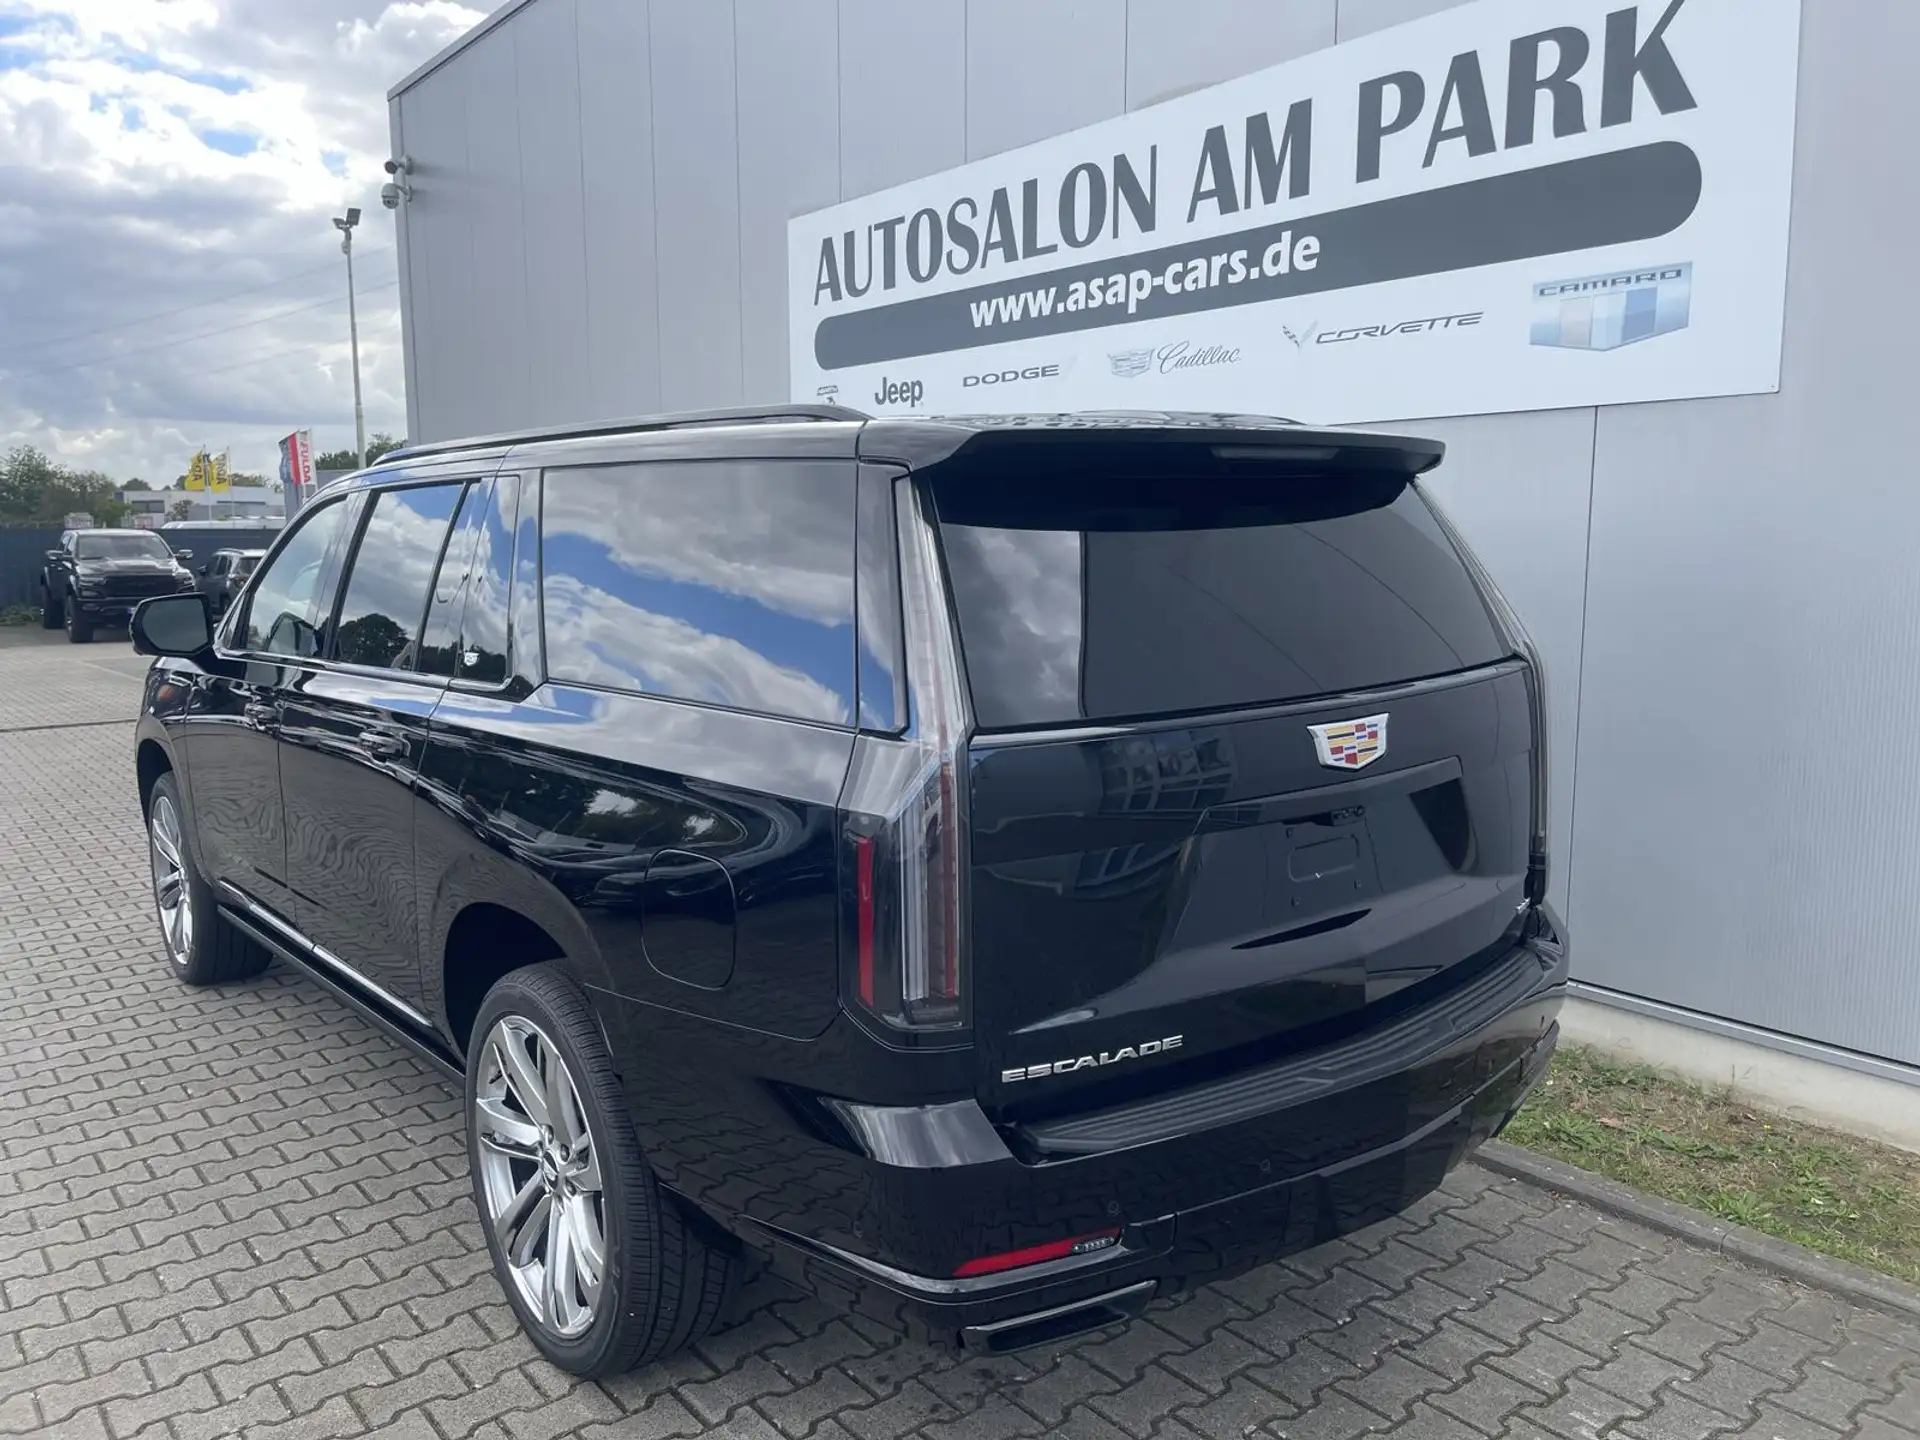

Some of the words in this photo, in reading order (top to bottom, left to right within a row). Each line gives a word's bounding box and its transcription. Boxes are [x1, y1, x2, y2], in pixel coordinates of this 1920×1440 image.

[814, 144, 1158, 306] AUTOSALON
[1186, 97, 1313, 224] AM
[1355, 0, 1698, 184] PARK
[969, 229, 1321, 329] www.asap-cars.de
[1538, 268, 1682, 297] CAMARO
[1315, 310, 1484, 345] CORVETTE
[1156, 340, 1240, 375] Cadillac
[874, 376, 924, 408] Jeep
[962, 364, 1060, 388] DODGE
[1001, 1034, 1184, 1084] ESCALADE
